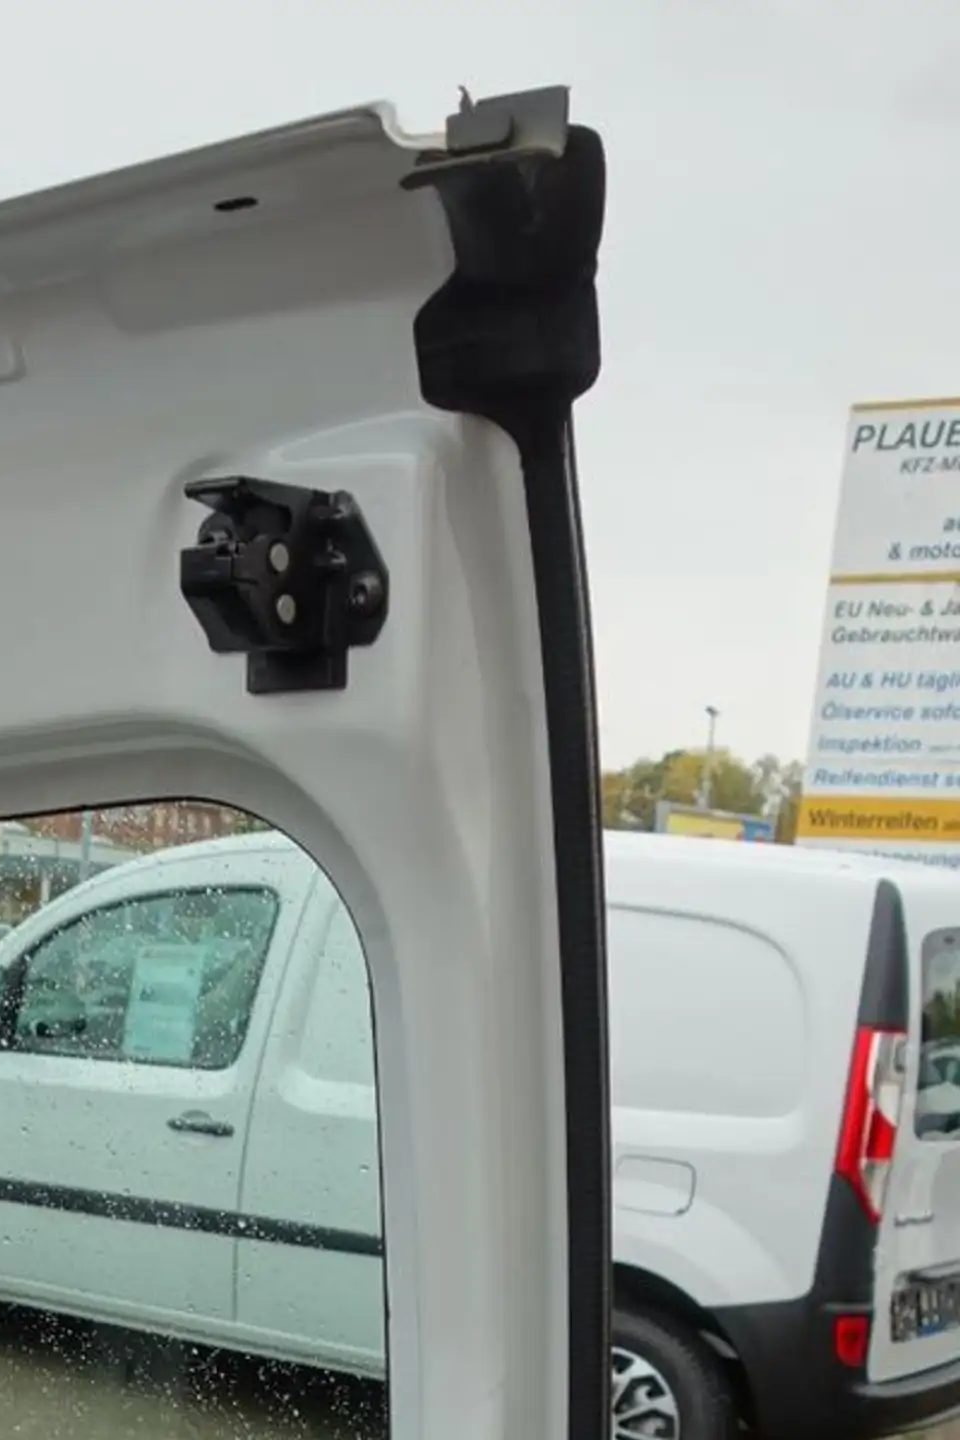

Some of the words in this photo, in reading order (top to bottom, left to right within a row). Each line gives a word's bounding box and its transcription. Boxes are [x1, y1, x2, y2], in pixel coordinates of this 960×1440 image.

[888, 541, 901, 560] &
[835, 599, 862, 618] EU
[920, 600, 933, 616] &
[826, 672, 856, 689] AU
[860, 672, 873, 688] &
[881, 672, 912, 689] HU
[808, 809, 938, 826] Winterreifen
